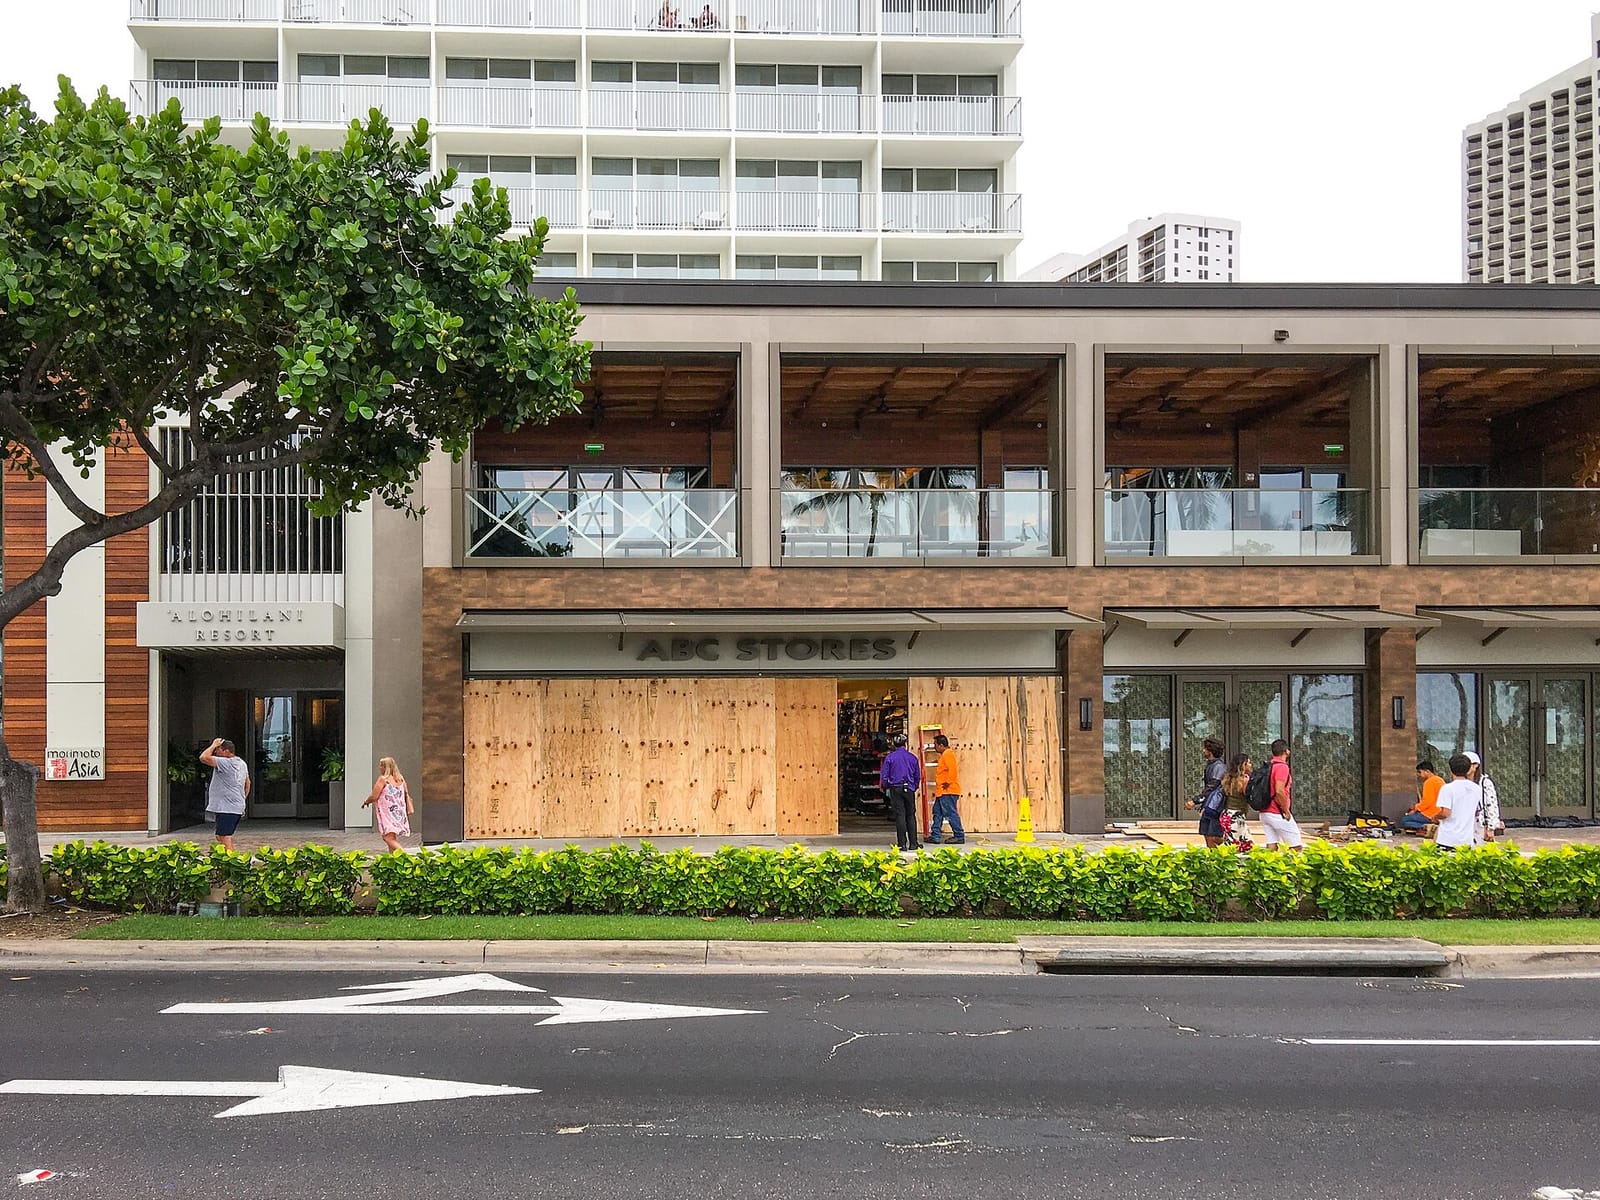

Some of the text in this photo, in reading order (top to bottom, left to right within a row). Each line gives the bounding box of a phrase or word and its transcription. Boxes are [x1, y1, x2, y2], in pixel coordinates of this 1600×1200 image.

[195, 629, 275, 641] RESORT
[636, 638, 897, 662] ABC STORES
[47, 750, 101, 758] morimoto
[68, 758, 100, 778] Asia
